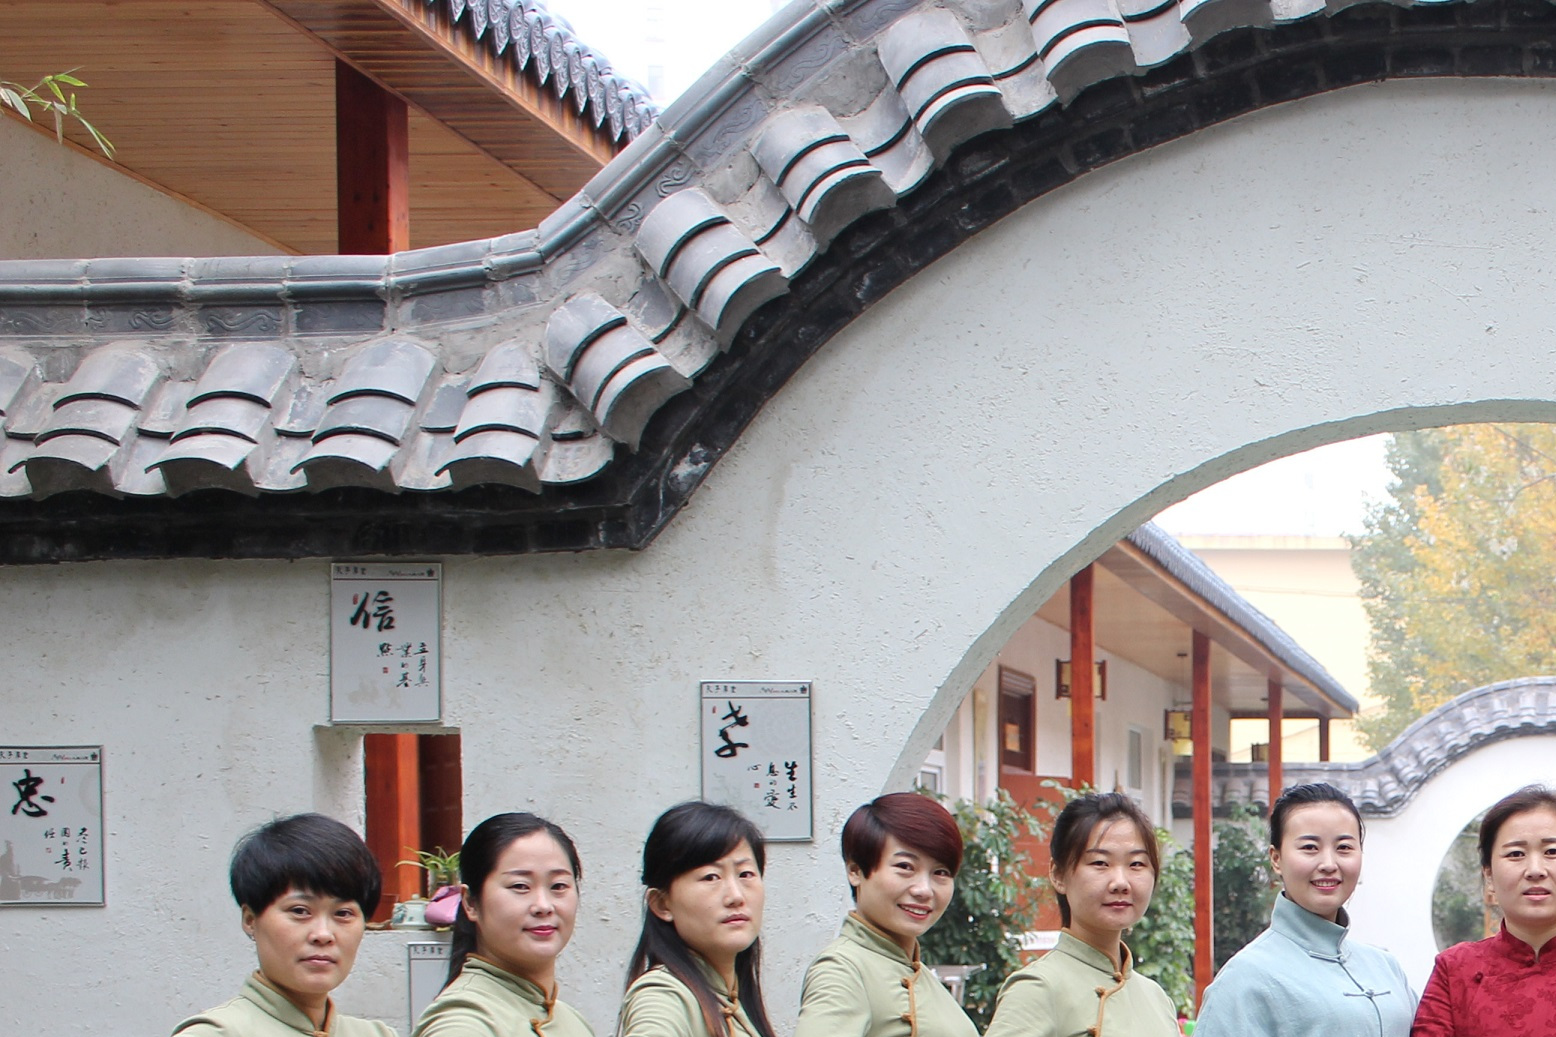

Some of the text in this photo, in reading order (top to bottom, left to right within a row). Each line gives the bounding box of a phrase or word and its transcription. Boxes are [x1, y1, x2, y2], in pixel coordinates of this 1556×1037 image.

[350, 590, 395, 632] 信
[714, 700, 750, 759] 孝
[11, 768, 56, 818] 忠
